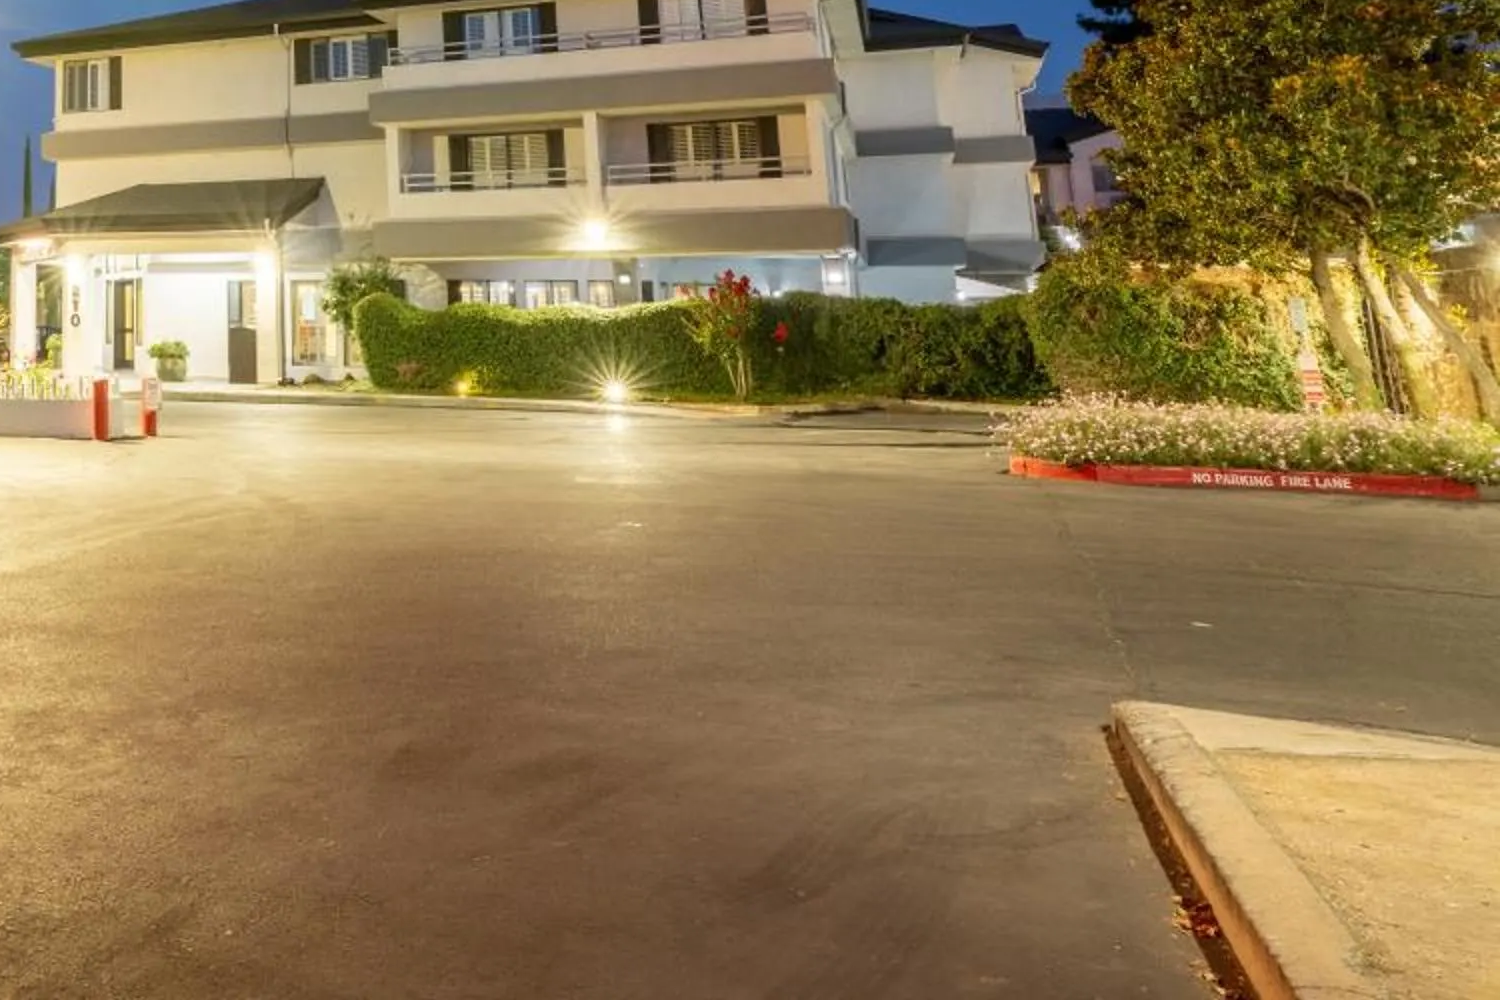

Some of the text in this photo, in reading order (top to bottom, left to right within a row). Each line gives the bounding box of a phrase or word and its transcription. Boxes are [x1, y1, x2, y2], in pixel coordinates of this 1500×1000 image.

[1192, 471, 1352, 489] NO PARKING FIRE LANE
